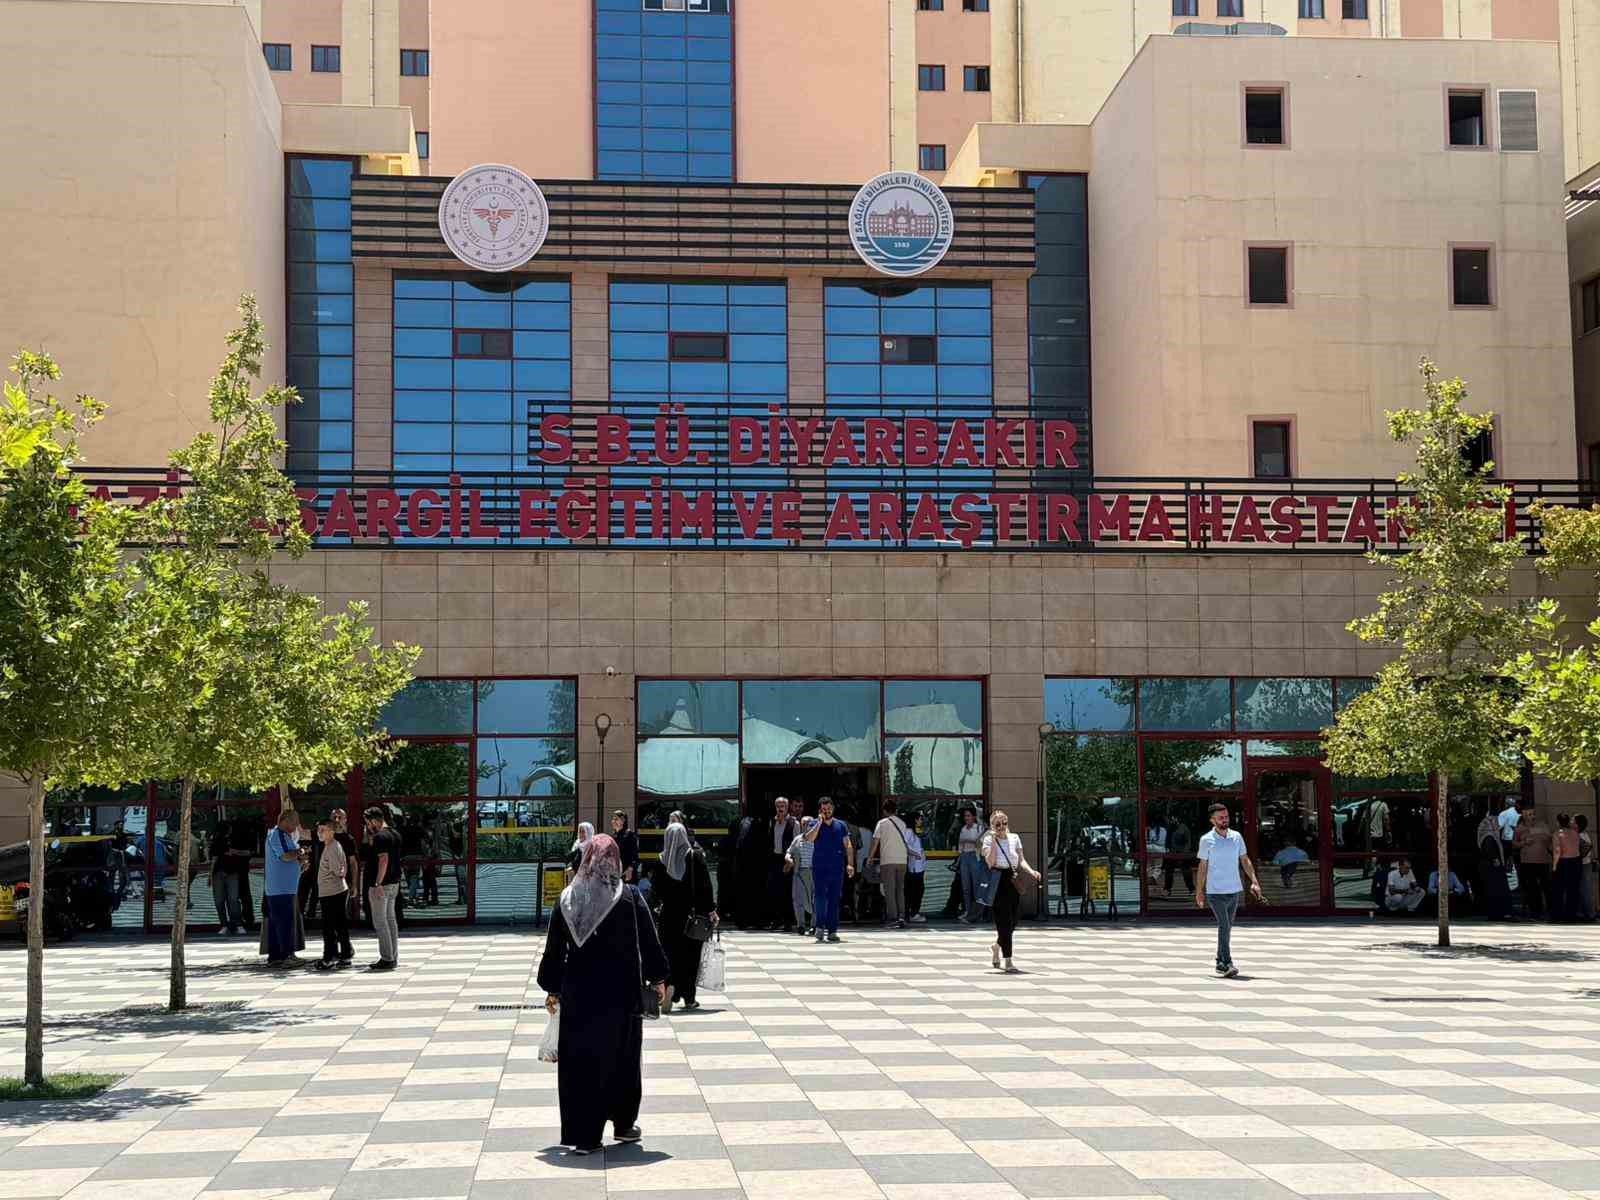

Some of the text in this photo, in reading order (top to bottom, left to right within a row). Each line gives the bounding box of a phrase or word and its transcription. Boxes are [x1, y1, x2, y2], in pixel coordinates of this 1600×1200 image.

[538, 403, 1079, 468] S.B.Ü. DİYARBAKIR
[519, 475, 714, 540] EĞİTİM
[731, 490, 802, 541] VE
[824, 492, 1176, 549] ARAŞTIRMA
[1187, 482, 1516, 544] HASTANİ
